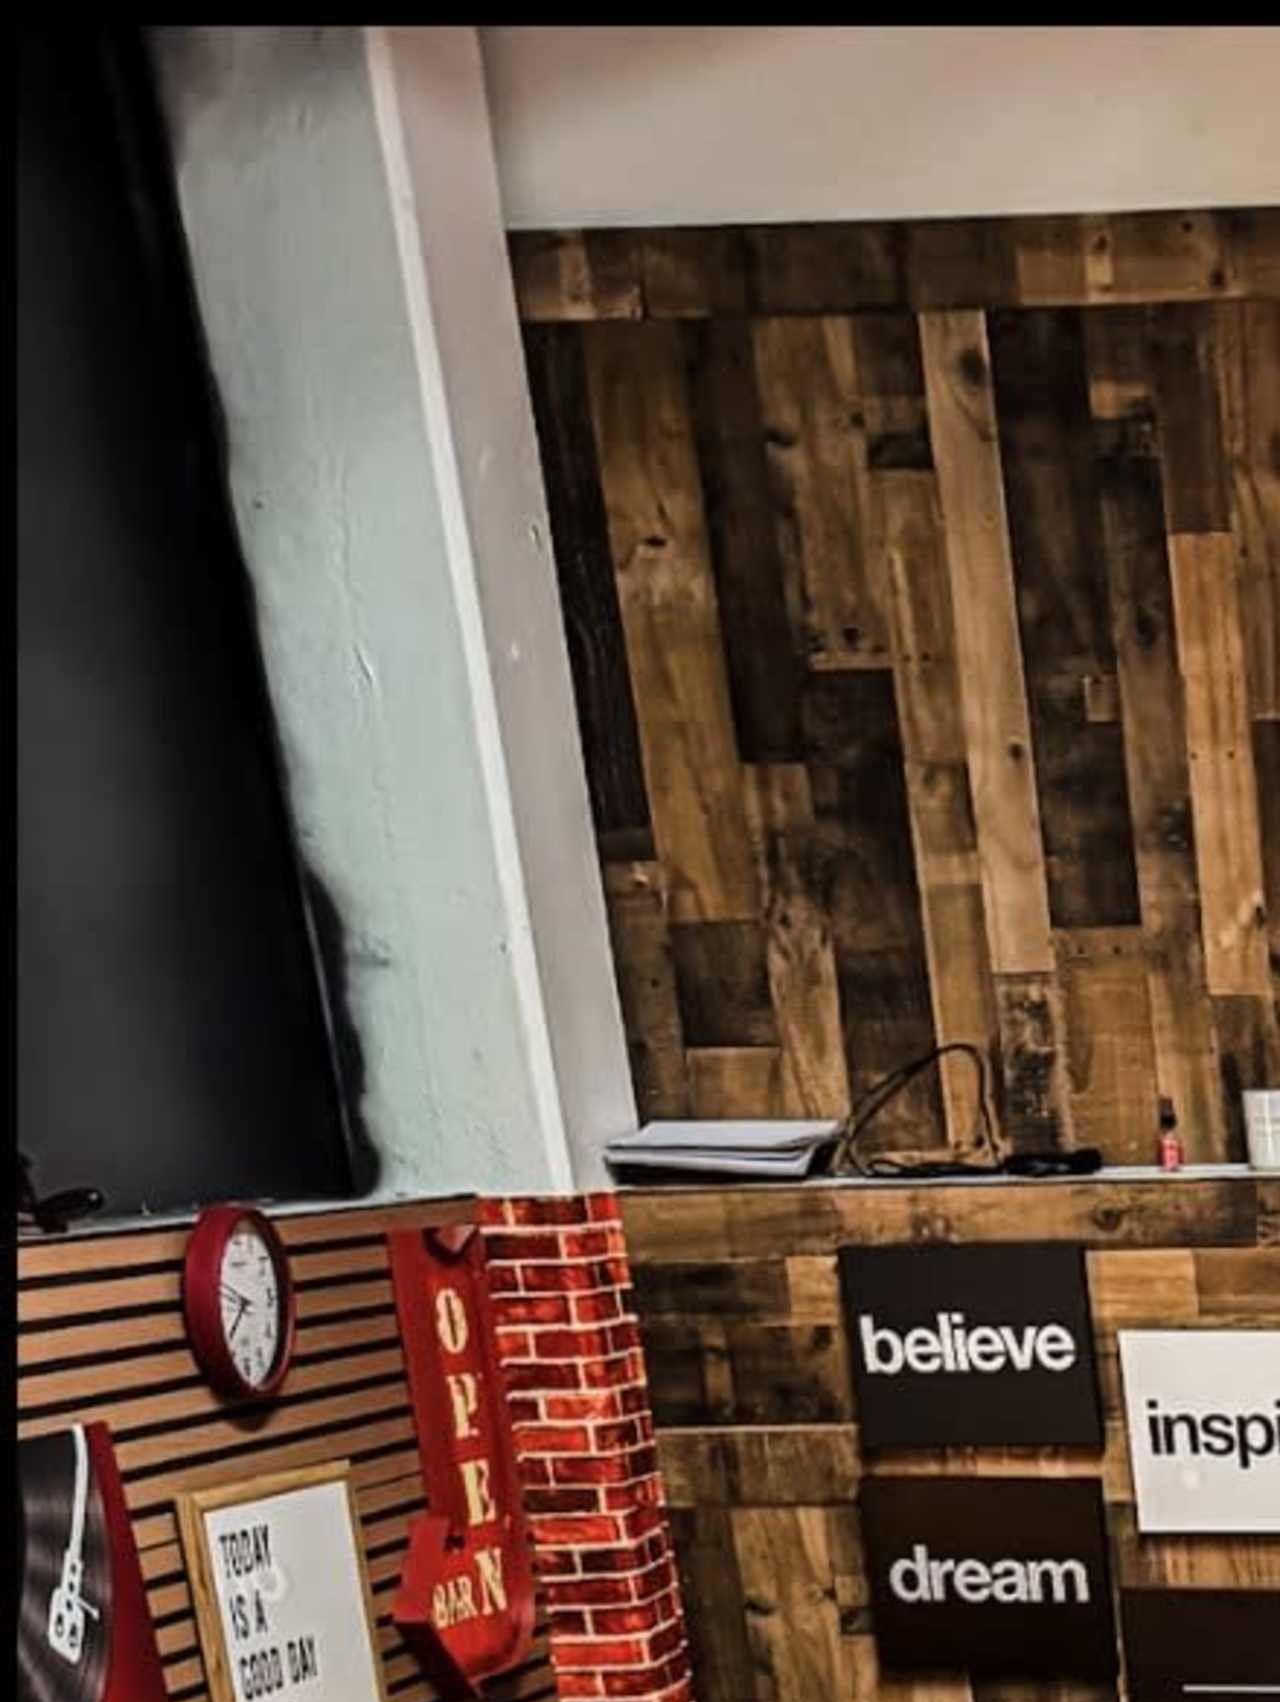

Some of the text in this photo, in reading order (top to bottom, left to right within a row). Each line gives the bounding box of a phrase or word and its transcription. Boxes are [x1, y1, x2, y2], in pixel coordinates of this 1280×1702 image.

[859, 1311, 1077, 1374] believe
[218, 1524, 272, 1579] TODAY
[889, 1543, 1091, 1603] dream
[229, 1589, 268, 1642] IS A
[239, 1634, 319, 1702] GOOD DAY
